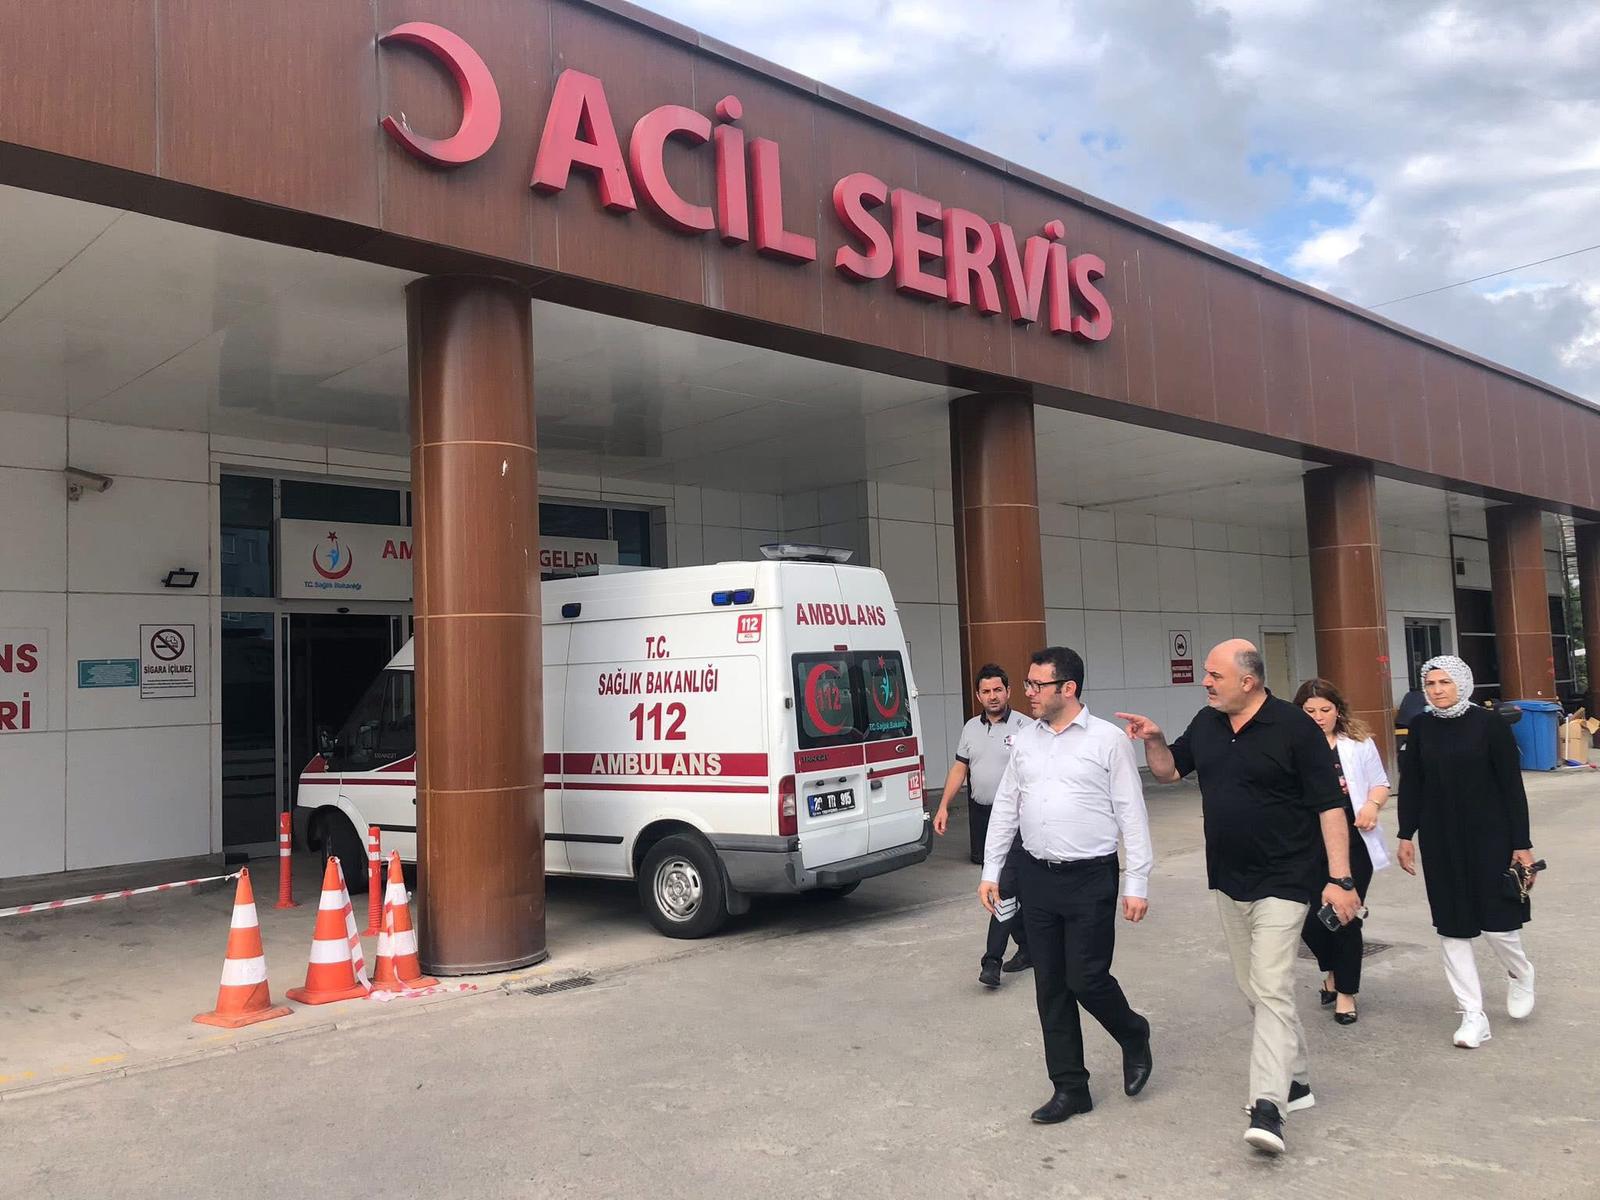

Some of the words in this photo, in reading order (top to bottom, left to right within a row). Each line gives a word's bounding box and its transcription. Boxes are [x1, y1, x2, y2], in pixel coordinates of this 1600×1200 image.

[530, 68, 817, 262] ACİL
[833, 172, 1113, 341] SERVİS
[540, 549, 597, 568] GELEN
[741, 617, 759, 631] 112
[796, 603, 886, 626] AMBULANS
[646, 636, 670, 659] T.C.
[144, 664, 167, 674] SİGARA
[167, 663, 193, 676] İÇİLMEZ
[598, 668, 643, 696] SAĞLIK
[646, 664, 718, 694] BAKANLIĞI
[817, 686, 842, 711] 112
[629, 702, 687, 741] 112
[591, 753, 722, 776] AMBULANS
